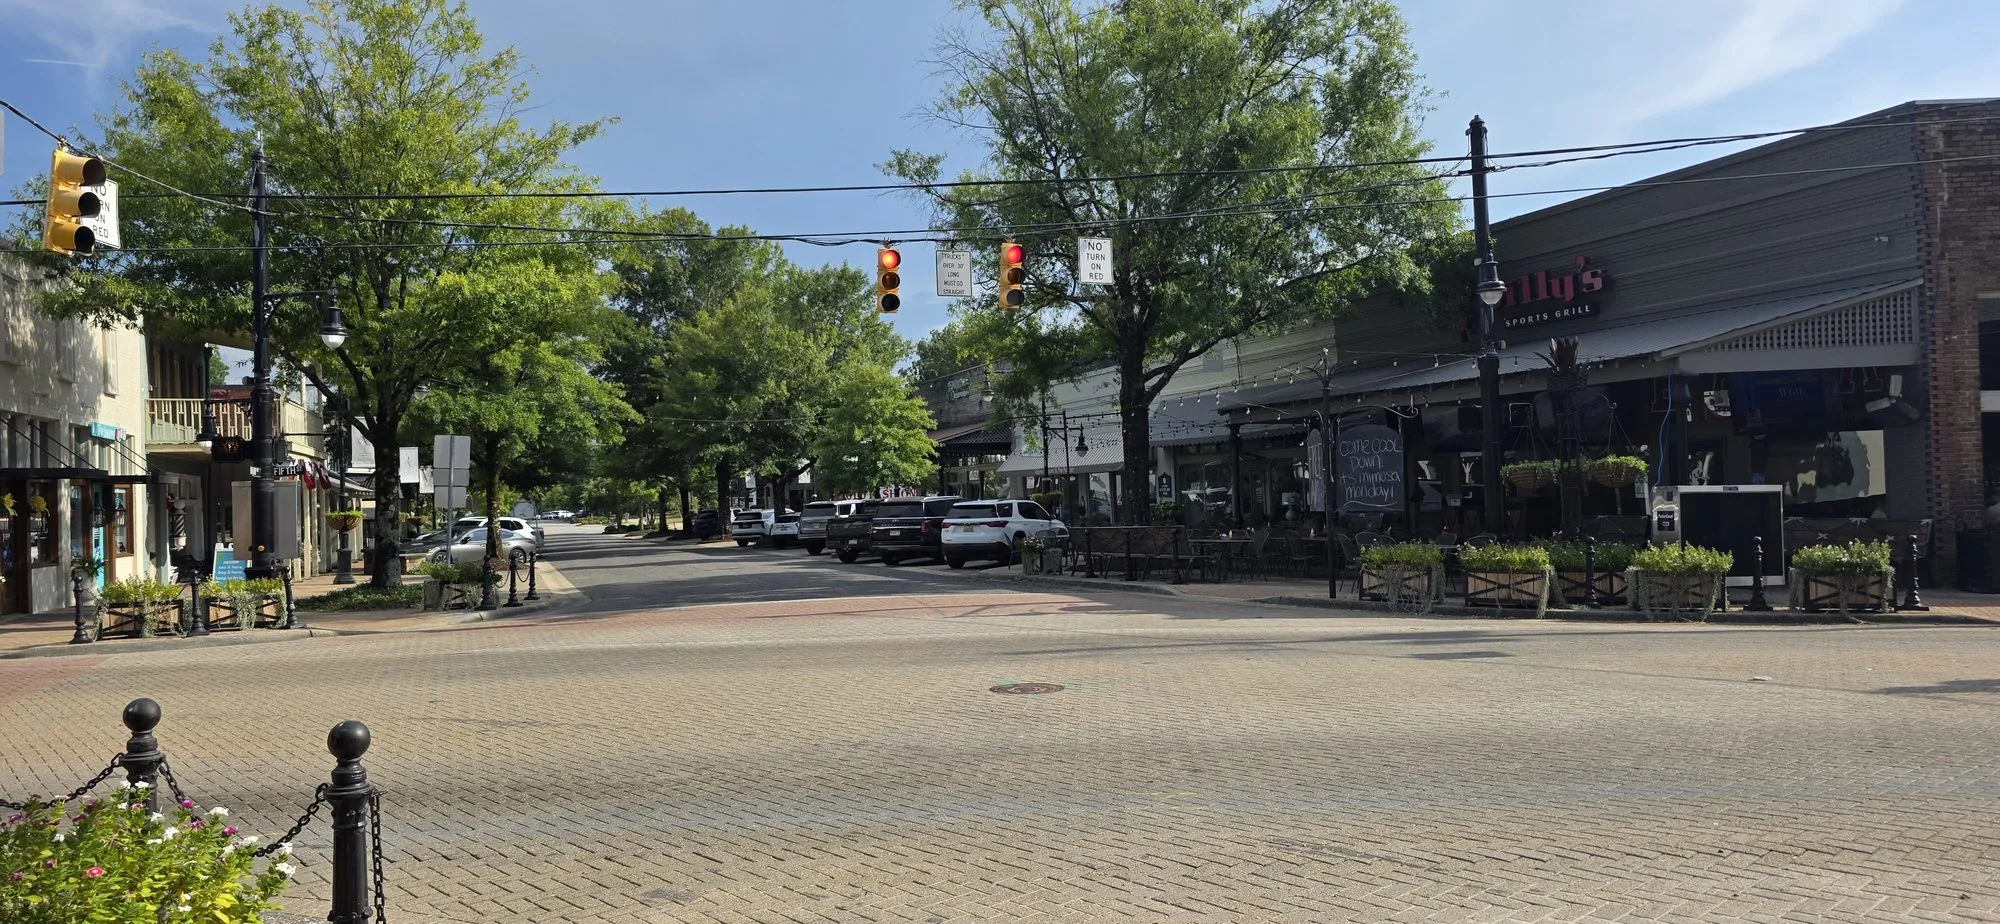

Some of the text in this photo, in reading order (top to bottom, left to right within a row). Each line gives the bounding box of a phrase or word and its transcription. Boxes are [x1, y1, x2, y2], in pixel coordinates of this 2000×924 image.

[93, 224, 109, 239] RED
[1088, 242, 1102, 251] NO
[1086, 253, 1105, 261] TURN
[1089, 272, 1103, 280] RED
[1498, 255, 1603, 308] illy's
[1504, 304, 1591, 328] SPORTS GRILL
[273, 465, 296, 476] FIFTH
[1359, 471, 1401, 484] mimosa
